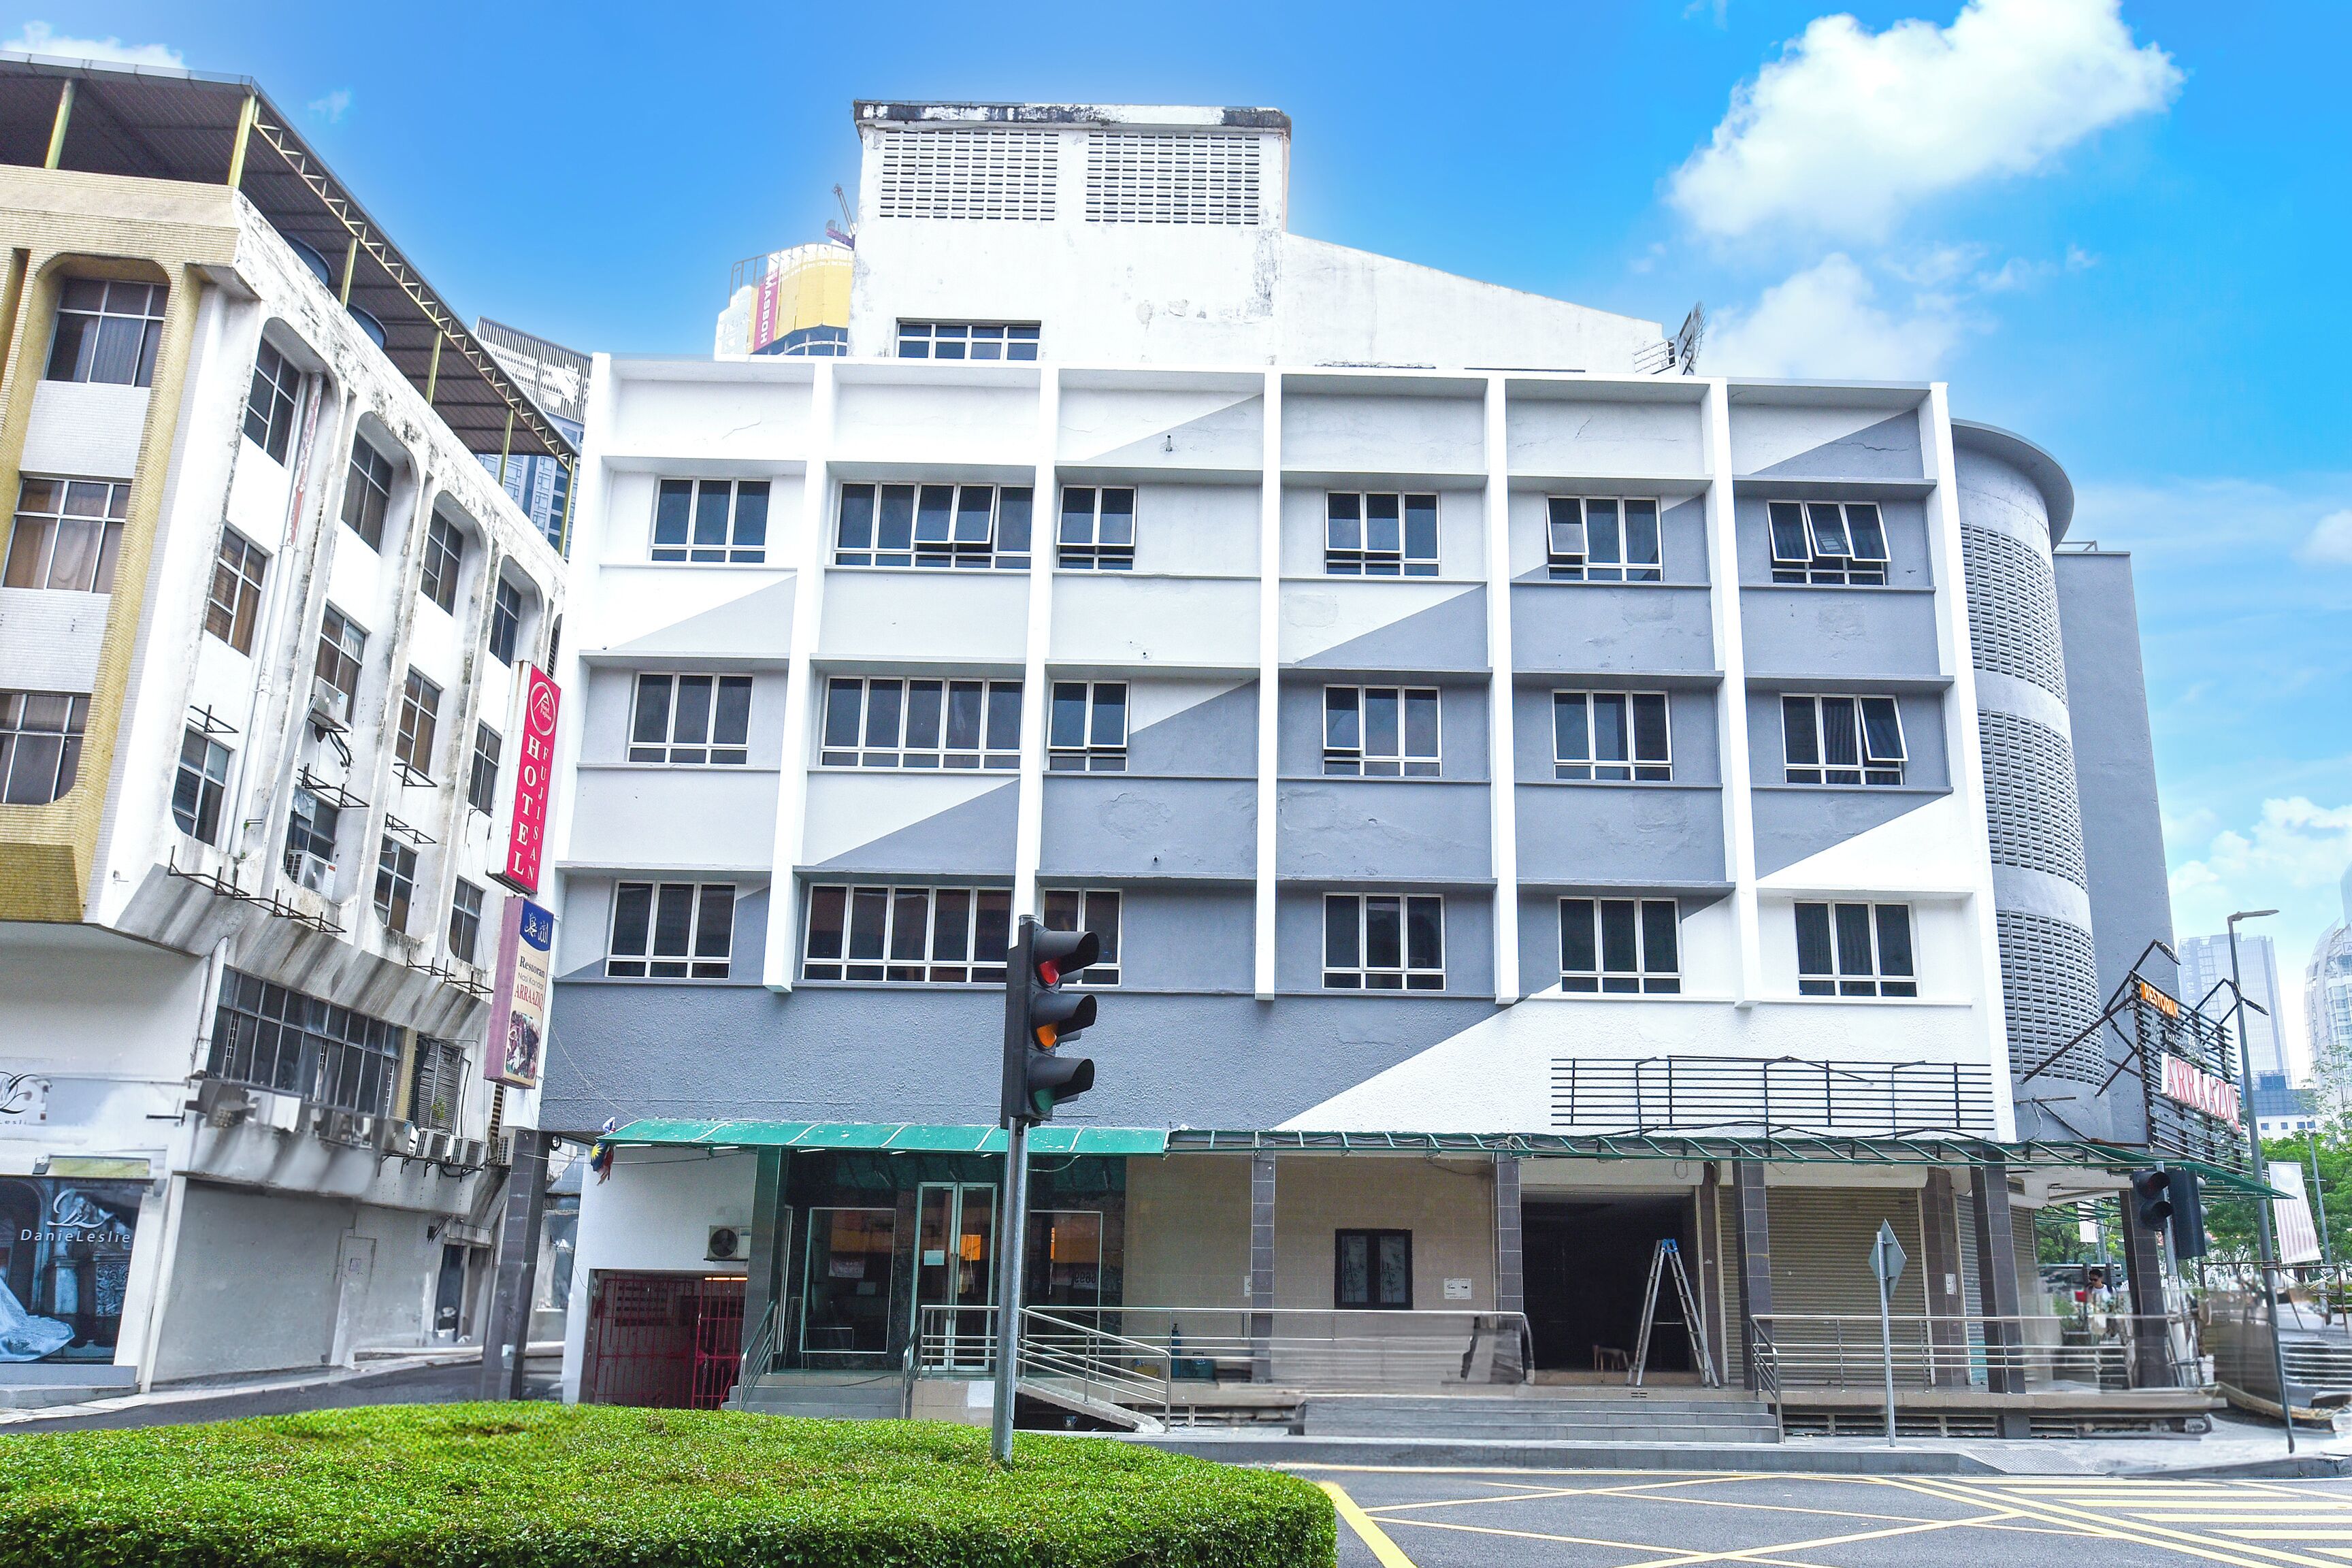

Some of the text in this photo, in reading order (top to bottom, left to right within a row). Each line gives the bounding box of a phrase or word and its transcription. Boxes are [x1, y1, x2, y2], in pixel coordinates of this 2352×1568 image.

[512, 734, 541, 876] HOTEL
[527, 746, 549, 881] FUJISAN
[518, 972, 544, 990] Nasi Kandar
[519, 955, 545, 979] Restoran
[514, 983, 544, 1012] ARRAAZIQ
[2140, 982, 2178, 1018] RESTORAN
[2161, 1052, 2242, 1134] ARRAAZIQ
[20, 1229, 131, 1243] DanieLeslie
